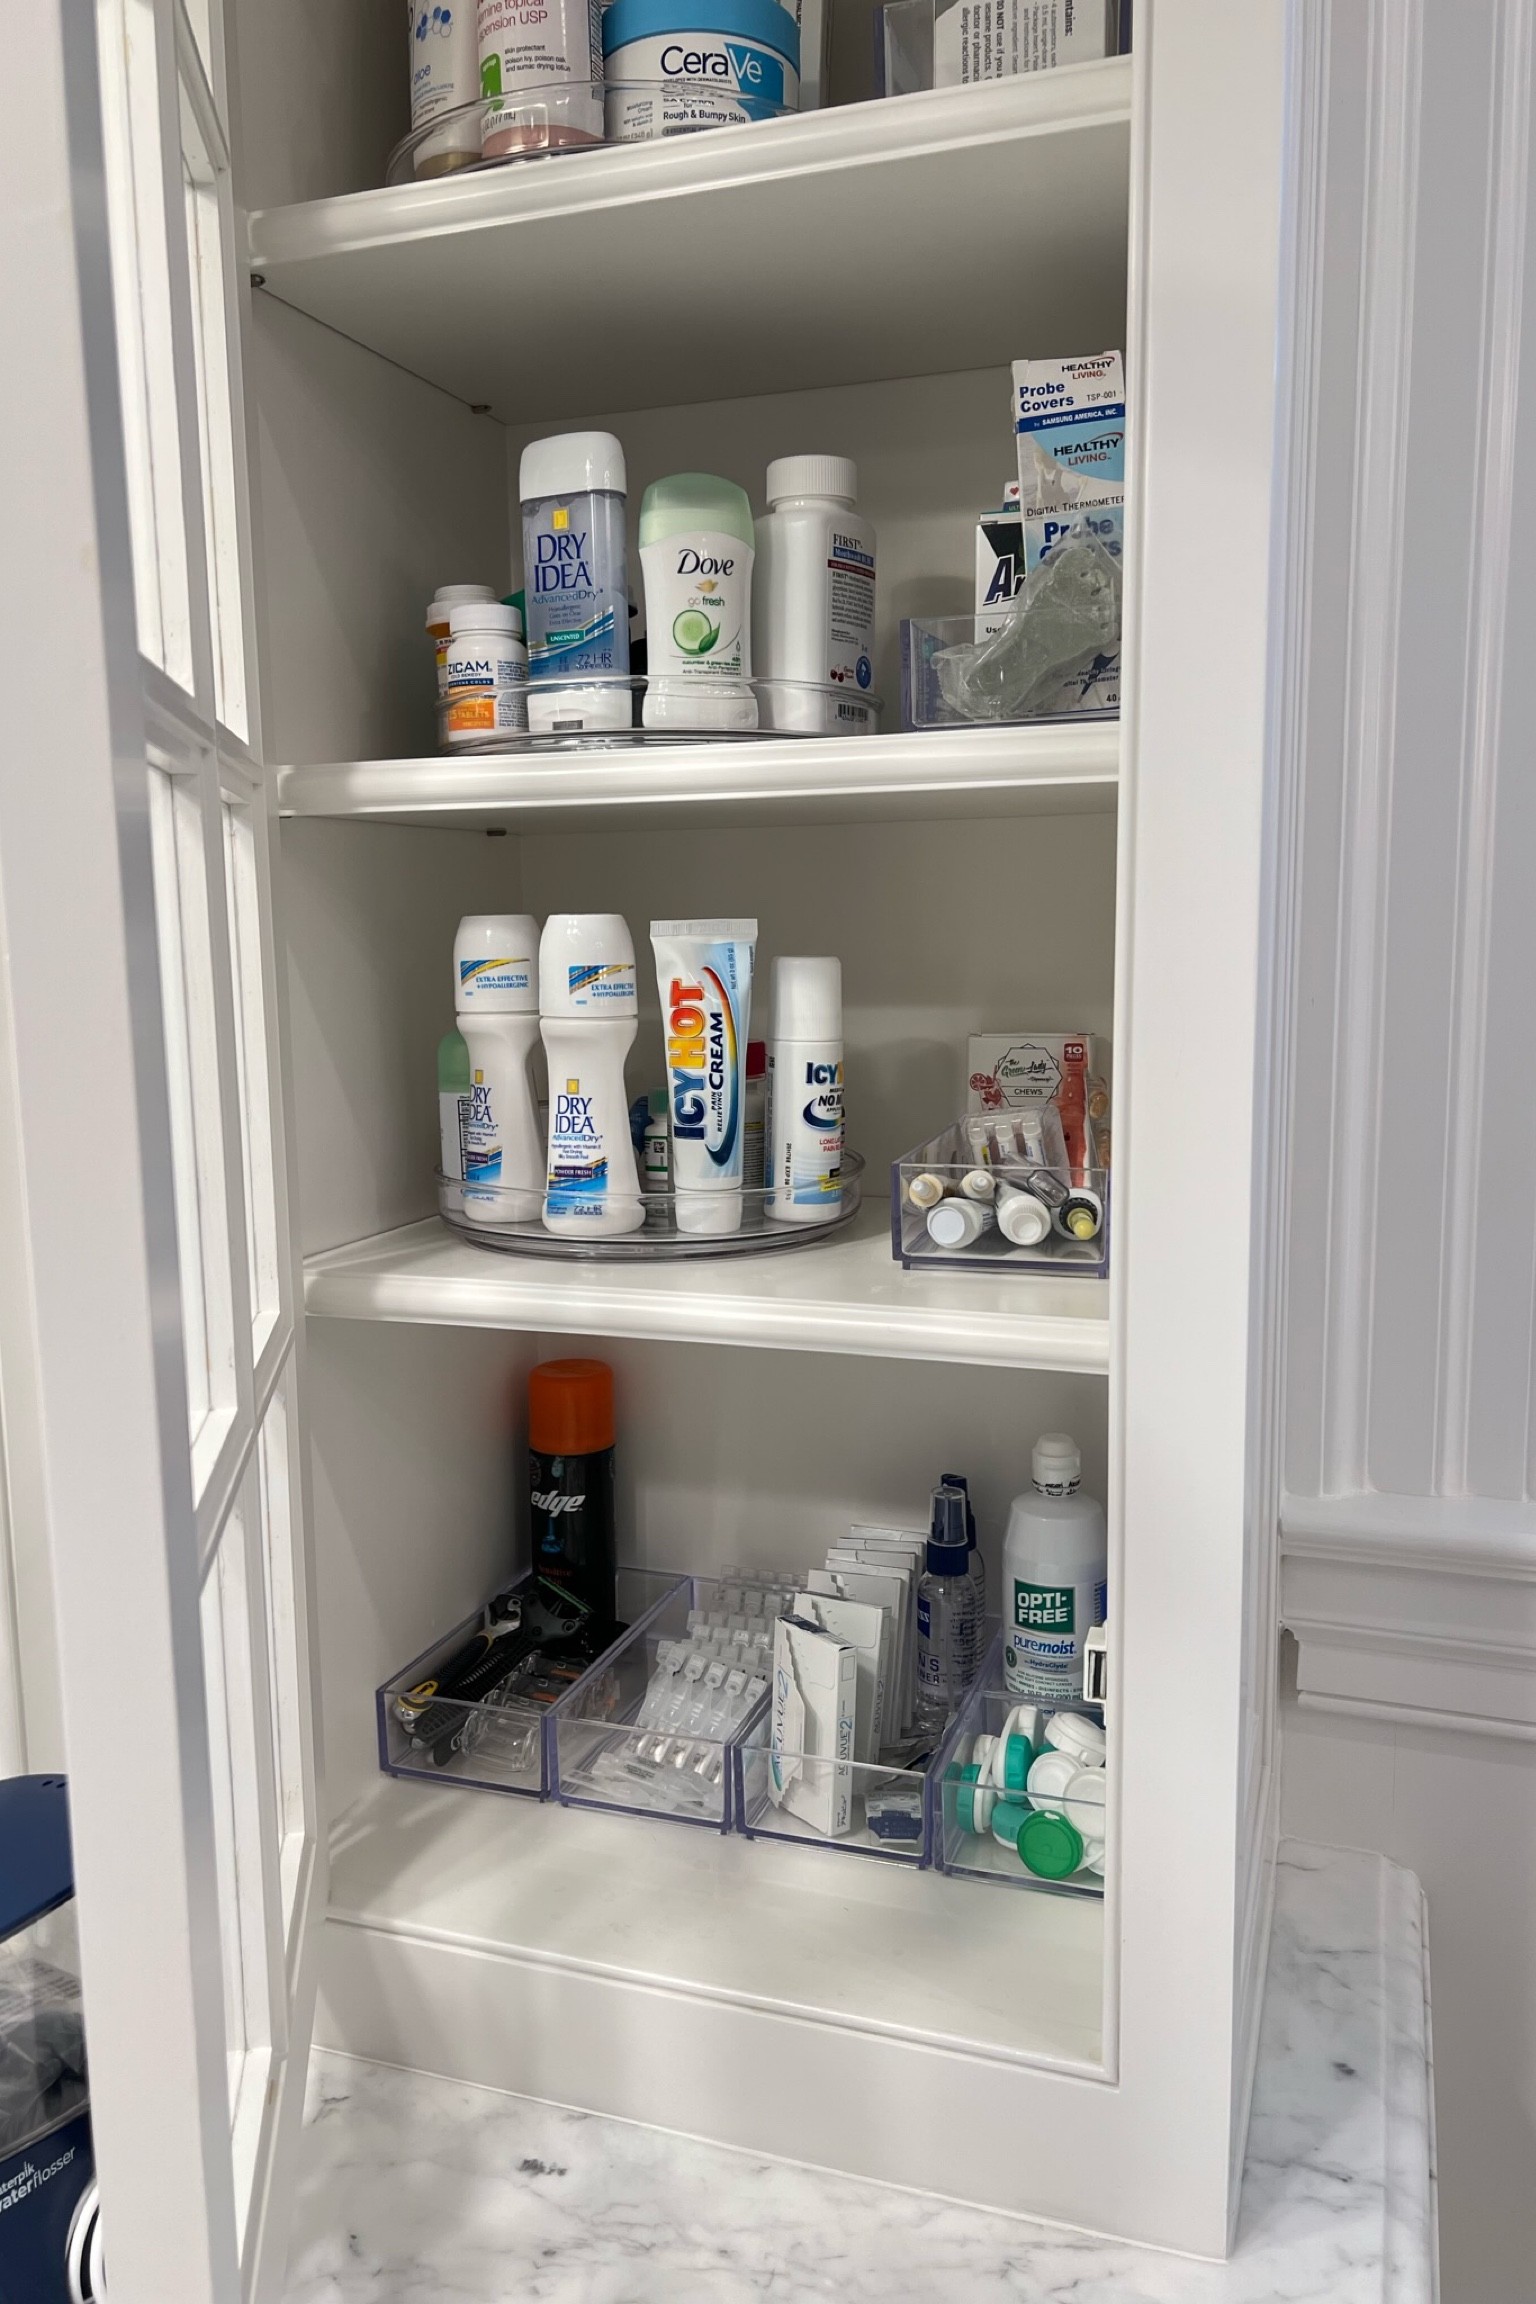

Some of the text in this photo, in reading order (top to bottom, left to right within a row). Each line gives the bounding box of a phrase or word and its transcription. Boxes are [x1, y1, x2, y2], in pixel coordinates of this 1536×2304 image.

[519, 10, 548, 25] USP
[996, 11, 1004, 30] NOT
[516, 44, 546, 54] protectant
[962, 36, 970, 75] reactions
[983, 34, 992, 73] products.
[504, 56, 523, 65] poison
[534, 55, 554, 63] poison
[505, 65, 516, 73] and
[516, 63, 535, 71] sumac
[536, 63, 555, 71] drying
[660, 45, 763, 83] CeraVe
[995, 55, 1003, 72] you
[663, 110, 689, 121] Rough
[690, 111, 697, 119] &
[699, 109, 728, 122] Bumpy
[728, 112, 746, 123] Skin
[1061, 359, 1114, 373] HEALTHY
[1072, 369, 1105, 380] LIVING
[1019, 381, 1066, 398] Probe
[1086, 390, 1117, 402] TSP-001
[1020, 395, 1075, 413] Covers
[1042, 414, 1073, 426] SAMSUNG
[1073, 410, 1103, 421] AMERICA,
[1104, 407, 1118, 417] INC.
[1053, 437, 1120, 457] HEALTHY
[1067, 451, 1108, 467] LIVING
[1026, 504, 1060, 517] DIGITAL
[537, 532, 587, 565] DRY
[833, 532, 858, 550] FIRST
[677, 548, 735, 577] Dove
[534, 561, 593, 593] IDEA
[687, 595, 726, 608] go fresh
[550, 632, 580, 642] UNSCENTED
[577, 652, 612, 665] 72 HR
[448, 660, 490, 675] ZICAM
[1106, 693, 1118, 703] 40
[475, 974, 529, 983] EXTRA EFFECTIVE
[591, 983, 613, 991] EXTRA
[708, 1011, 724, 1091] CREAM
[1064, 1046, 1083, 1054] 10
[1001, 1059, 1050, 1078] Green Lady
[470, 1084, 493, 1105] DRY
[1014, 1088, 1043, 1096] CHEWS
[557, 1094, 593, 1115] DRY
[818, 1095, 836, 1107] NO
[469, 1104, 493, 1123] DEA
[716, 1091, 724, 1133] RELIEVING
[554, 1113, 596, 1134] IDEA
[554, 1168, 575, 1176] POWDER
[530, 1490, 586, 1518] edge
[1017, 1592, 1068, 1608] OPTI-
[1018, 1608, 1069, 1623] FREE
[1013, 1634, 1075, 1655] puremoist
[0, 2146, 76, 2213] aterflosser
